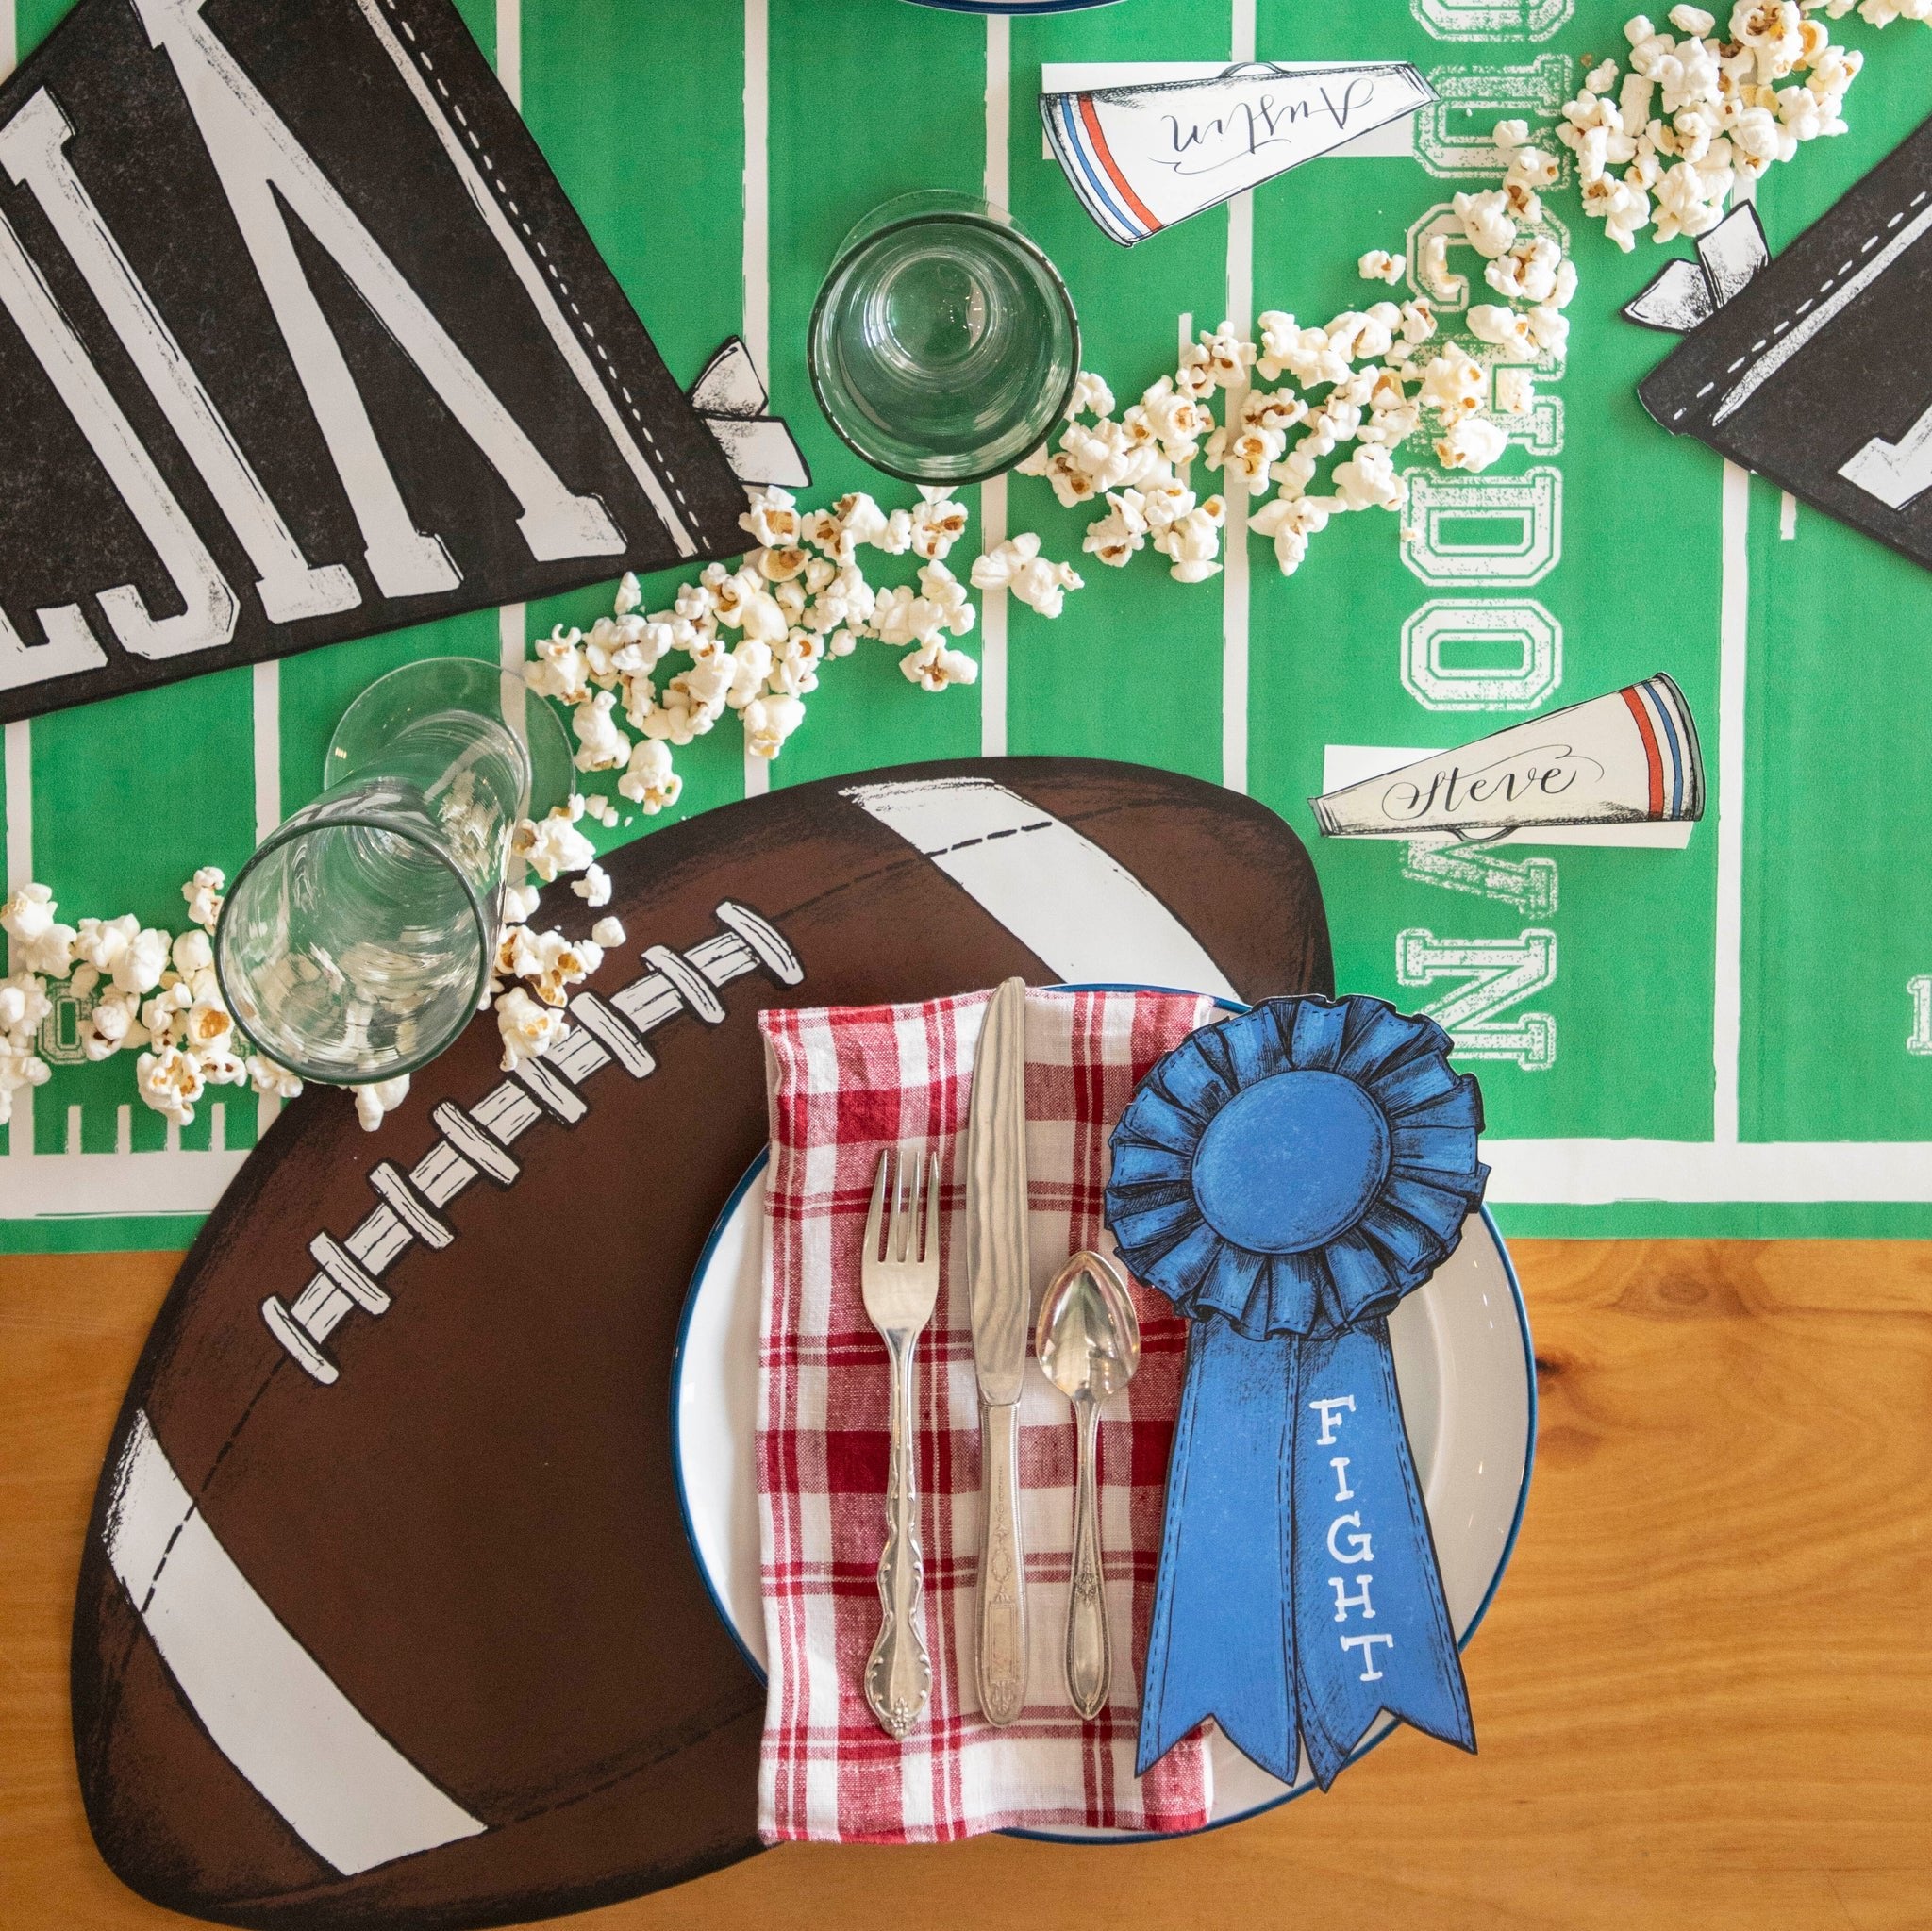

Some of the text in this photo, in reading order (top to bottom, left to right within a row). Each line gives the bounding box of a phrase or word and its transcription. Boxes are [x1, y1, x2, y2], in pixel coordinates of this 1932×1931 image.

[1148, 78, 1374, 175] Austin
[0, 0, 627, 690] VIC
[1382, 744, 1604, 820] Steve
[1309, 1394, 1393, 1681] FIGHT
